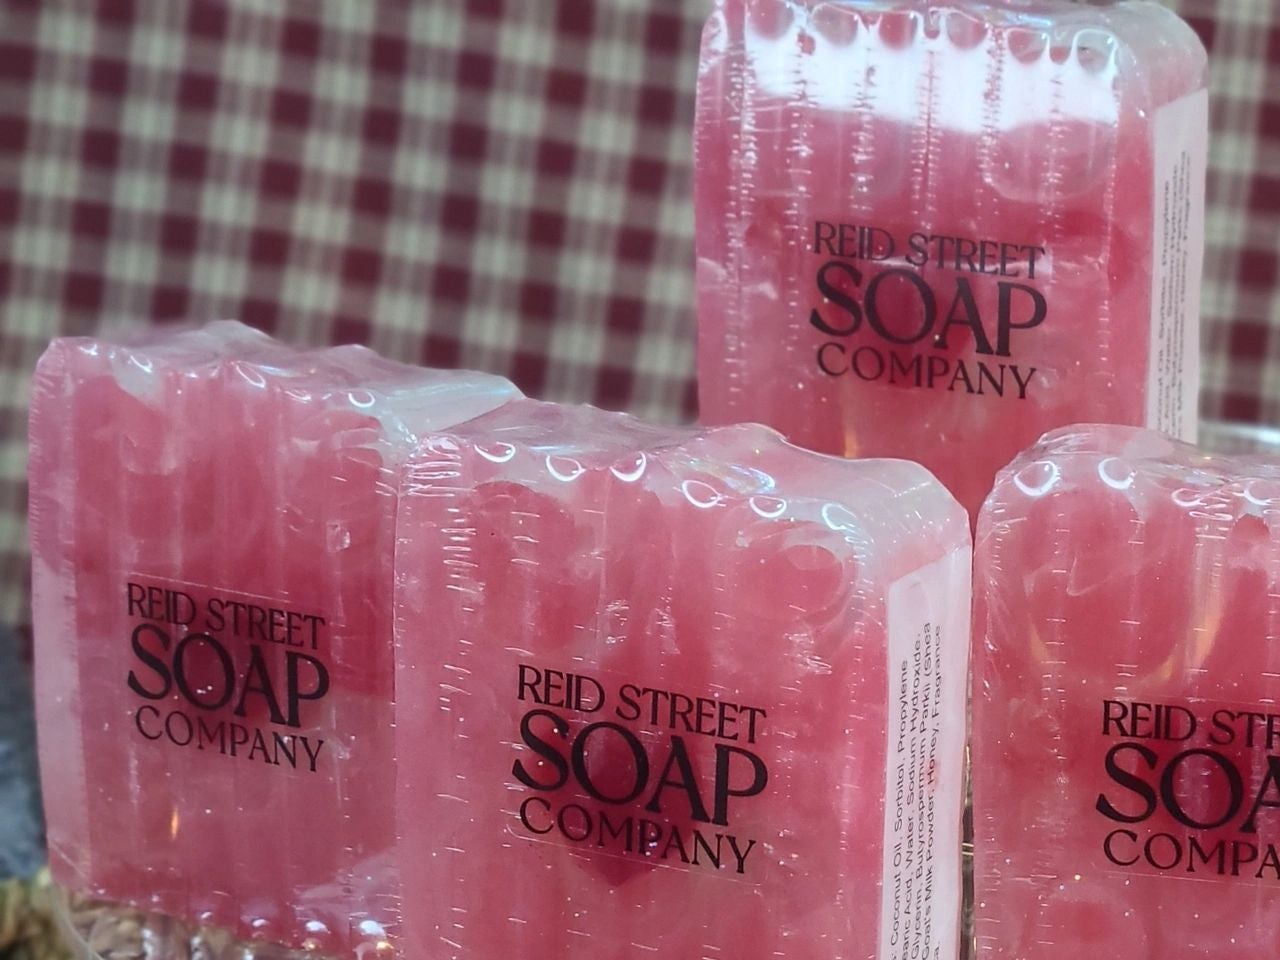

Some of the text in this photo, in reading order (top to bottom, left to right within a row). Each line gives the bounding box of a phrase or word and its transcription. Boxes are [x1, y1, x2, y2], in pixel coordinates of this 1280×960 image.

[813, 221, 1045, 279] REID STREET
[810, 261, 1047, 357] SOAP
[817, 342, 1037, 399] COMPANY
[127, 583, 325, 650] REID STREET
[127, 623, 329, 728] SOAP
[517, 664, 767, 744] REID STREET
[136, 705, 324, 772] COMPANY
[1102, 700, 1197, 741] REID
[512, 709, 768, 826] SOAP
[906, 737, 916, 806] Sodium
[924, 865, 932, 902] Milk
[931, 626, 941, 718] Fragrance
[520, 797, 756, 874] COMPANY
[890, 871, 901, 946] Coconut
[897, 660, 908, 752] Propylene
